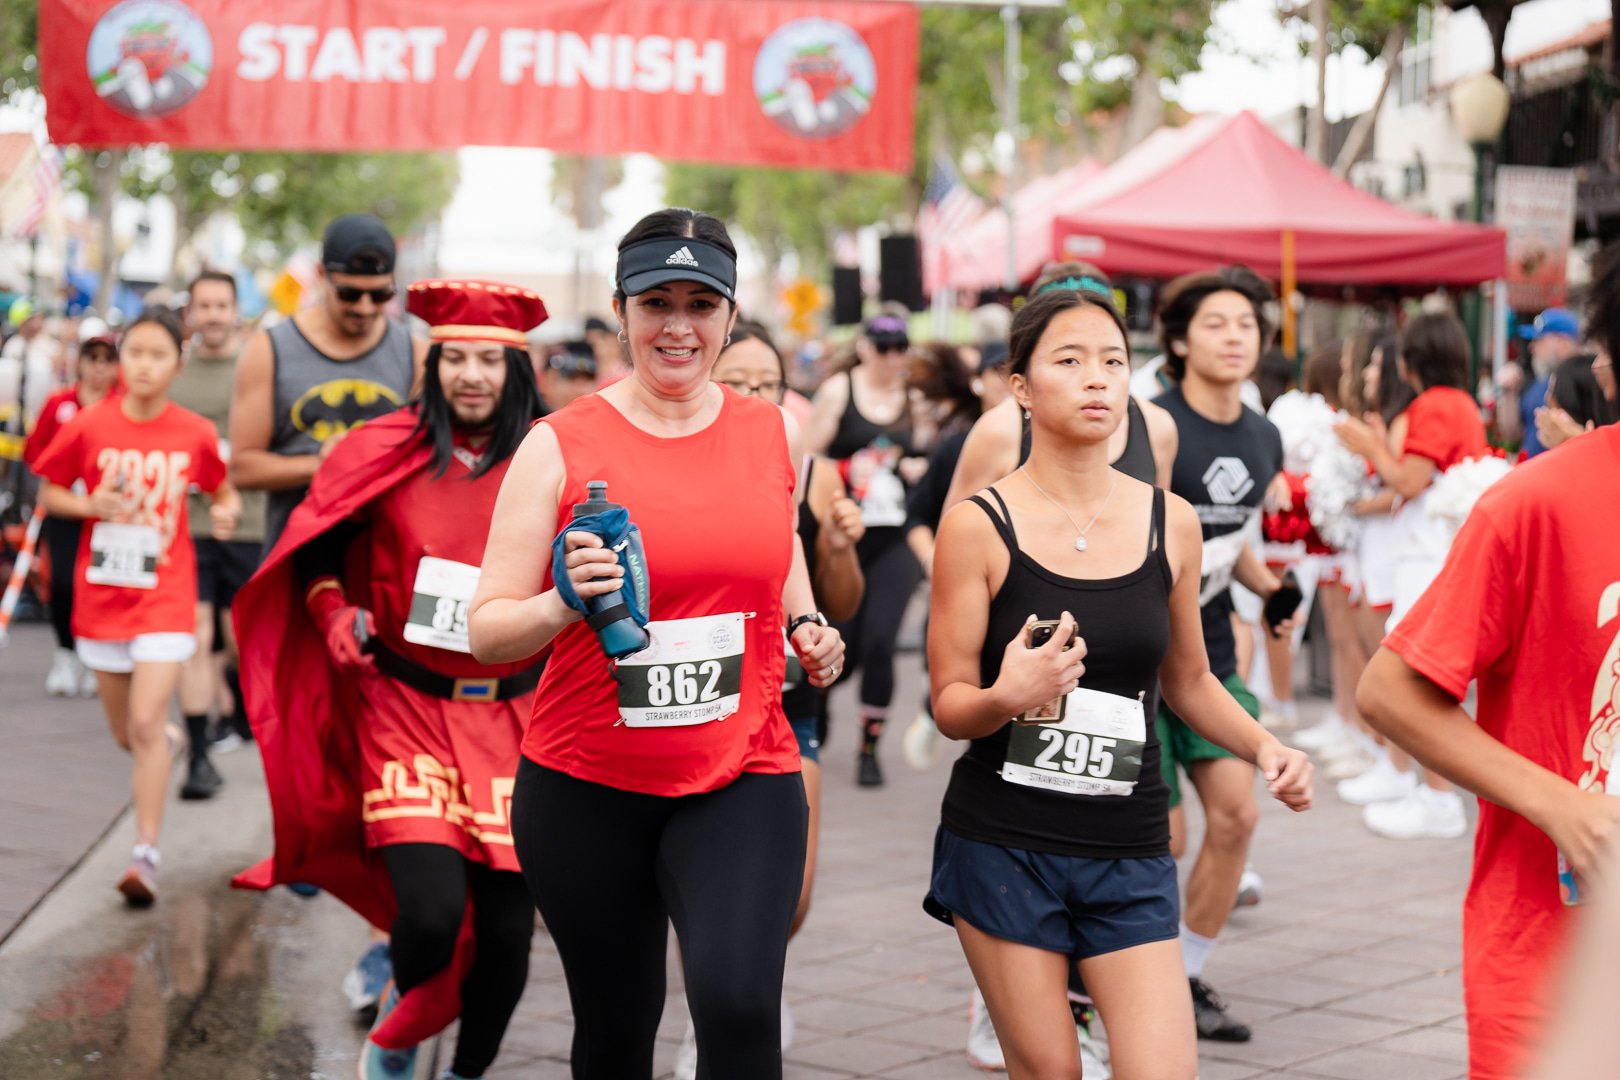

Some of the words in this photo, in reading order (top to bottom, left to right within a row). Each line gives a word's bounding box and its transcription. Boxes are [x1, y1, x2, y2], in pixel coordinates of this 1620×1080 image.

[237, 22, 446, 83] START
[453, 25, 489, 81] /
[500, 28, 726, 96] FINISH
[665, 257, 699, 267] adidas
[646, 660, 722, 707] 862
[645, 710, 692, 721] STRAWBERRY
[694, 707, 715, 718] STOMP
[1034, 729, 1117, 778] 295
[1029, 772, 1076, 787] STRAWBERRY
[1077, 780, 1101, 790] STOMP
